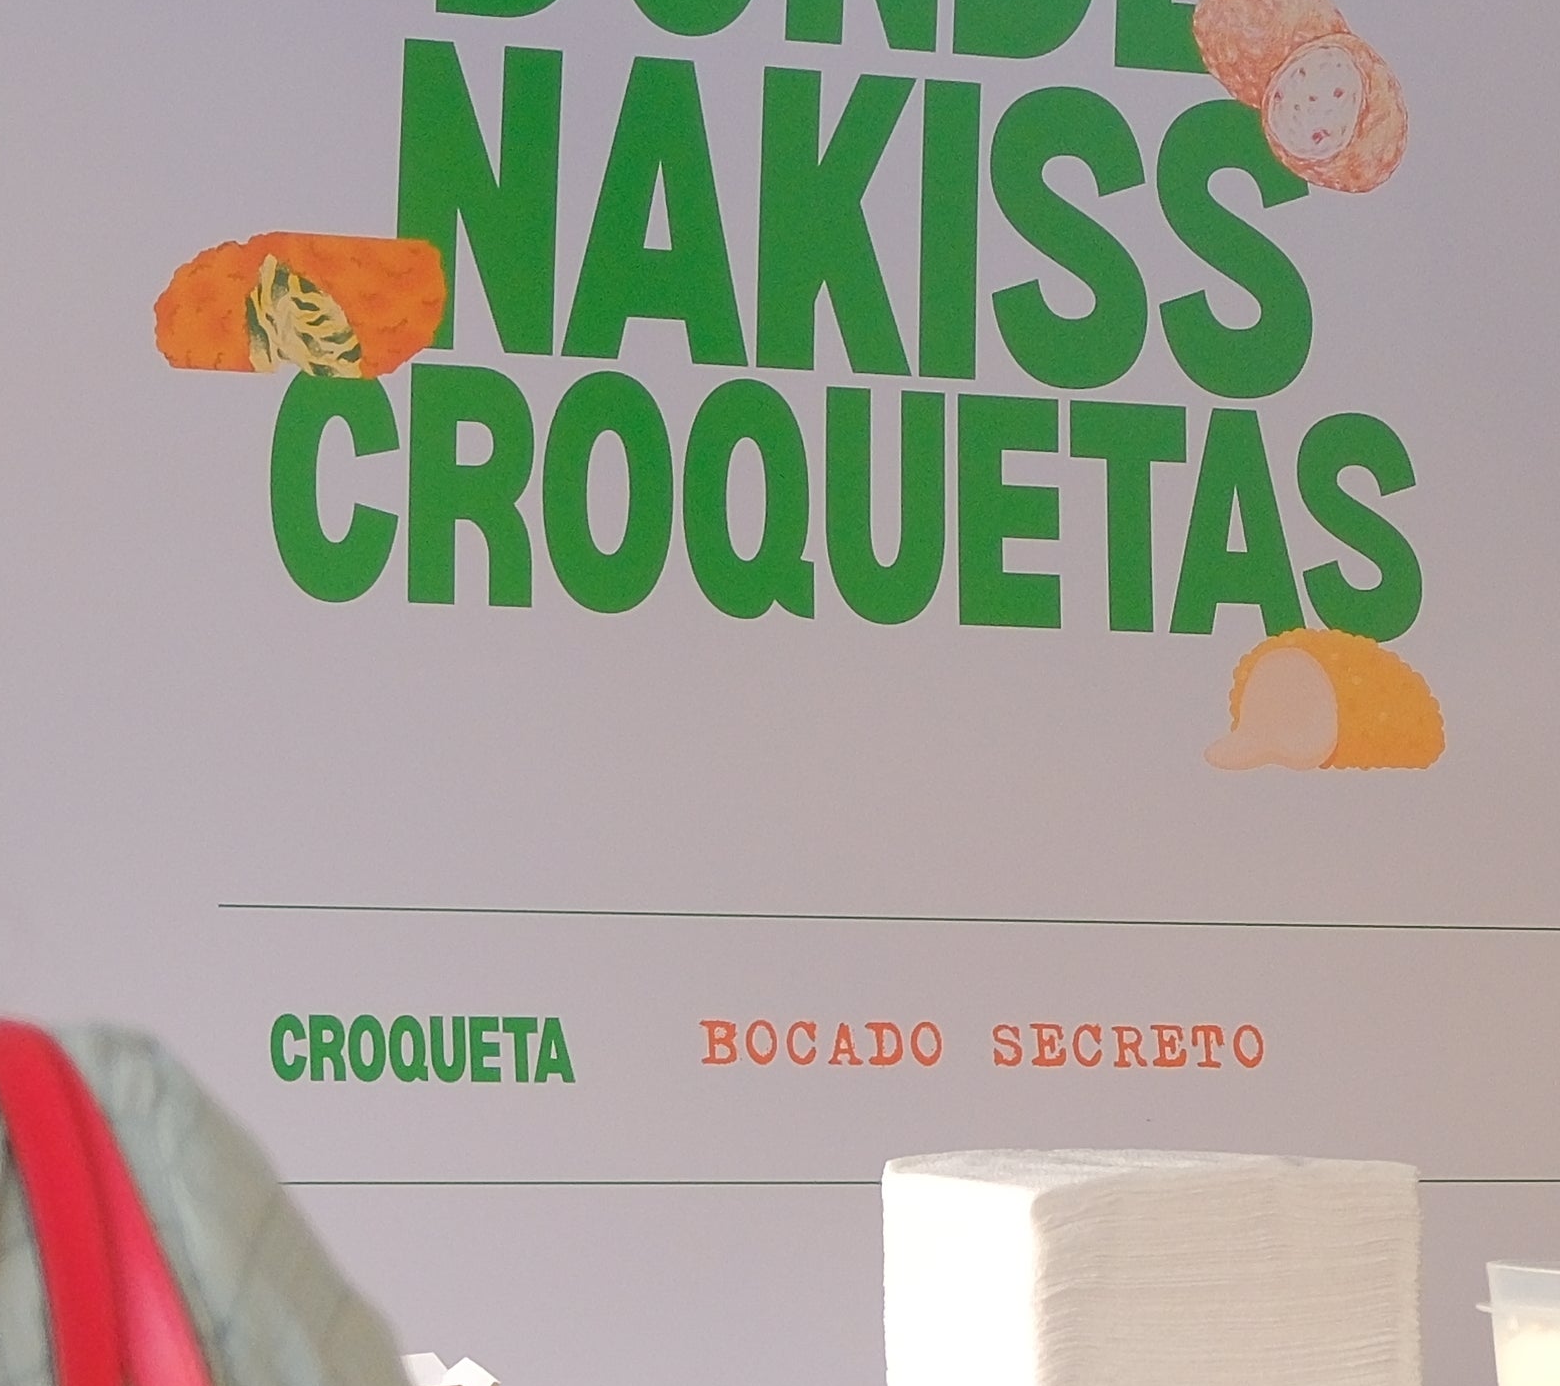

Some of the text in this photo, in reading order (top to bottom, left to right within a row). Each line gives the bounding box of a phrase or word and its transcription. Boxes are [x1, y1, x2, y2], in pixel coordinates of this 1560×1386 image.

[396, 37, 1314, 400] NAKISS
[269, 361, 1424, 645] CROQUETAS
[270, 1013, 1266, 1085] CROQUETA BOCADO SECRETO
